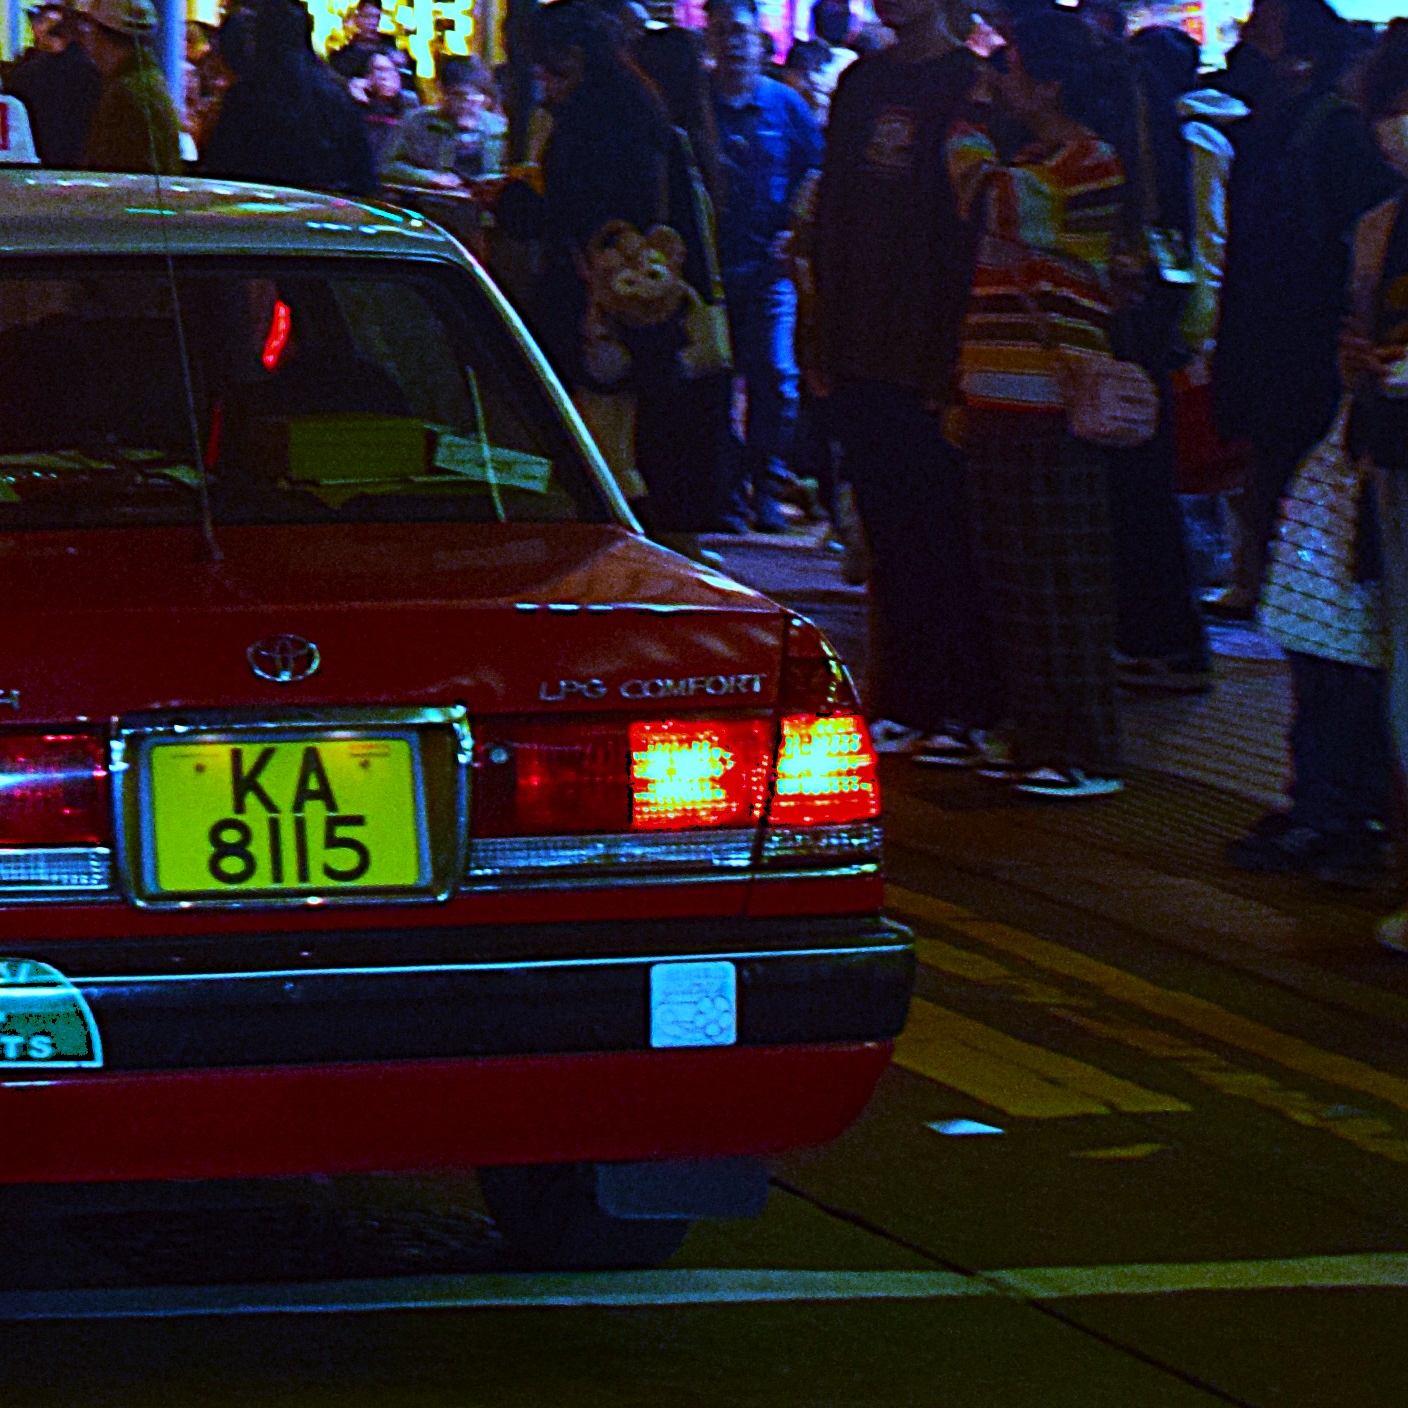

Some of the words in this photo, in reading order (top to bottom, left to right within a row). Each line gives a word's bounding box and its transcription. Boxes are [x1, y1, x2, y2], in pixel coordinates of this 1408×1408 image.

[539, 678, 608, 702] LPG
[619, 673, 767, 699] COMFORT
[230, 746, 339, 815] KA
[208, 815, 370, 883] 8115
